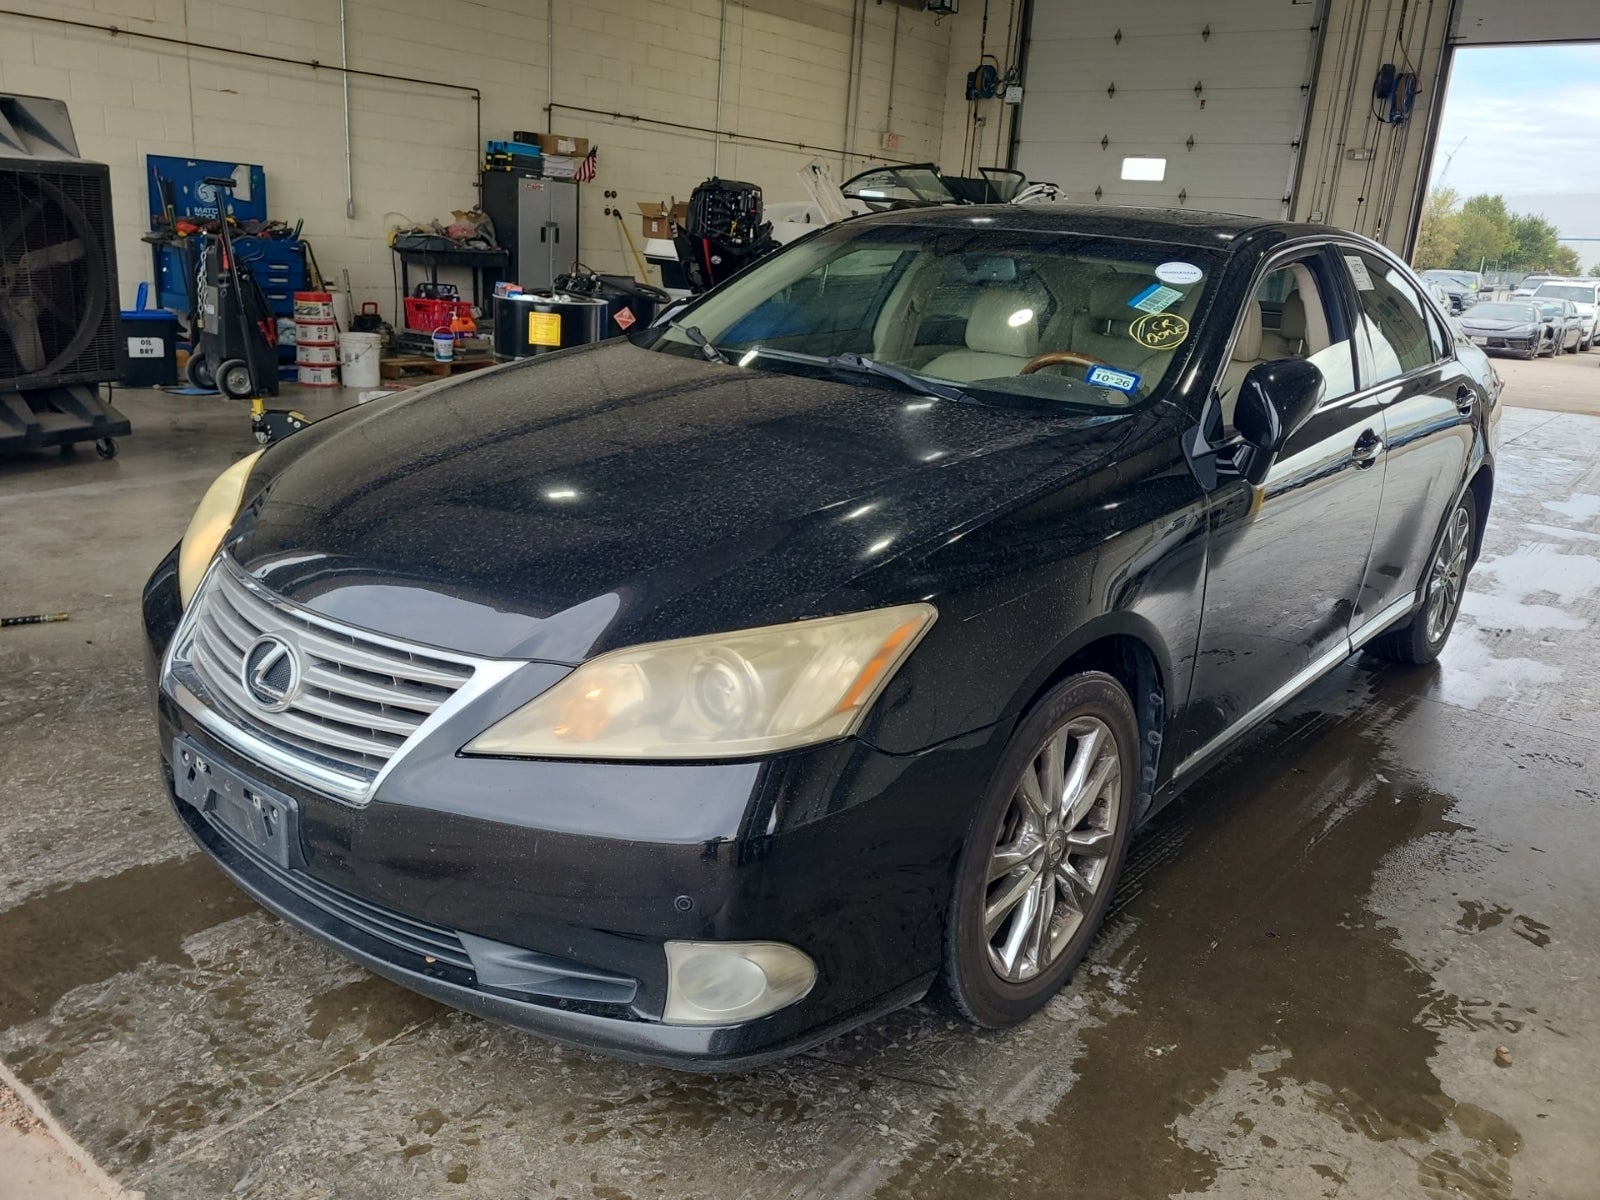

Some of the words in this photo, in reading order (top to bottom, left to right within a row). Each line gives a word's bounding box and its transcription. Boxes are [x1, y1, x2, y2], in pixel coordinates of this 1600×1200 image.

[194, 206, 218, 214] MATC
[1095, 373, 1110, 382] 10
[1114, 377, 1131, 388] 26
